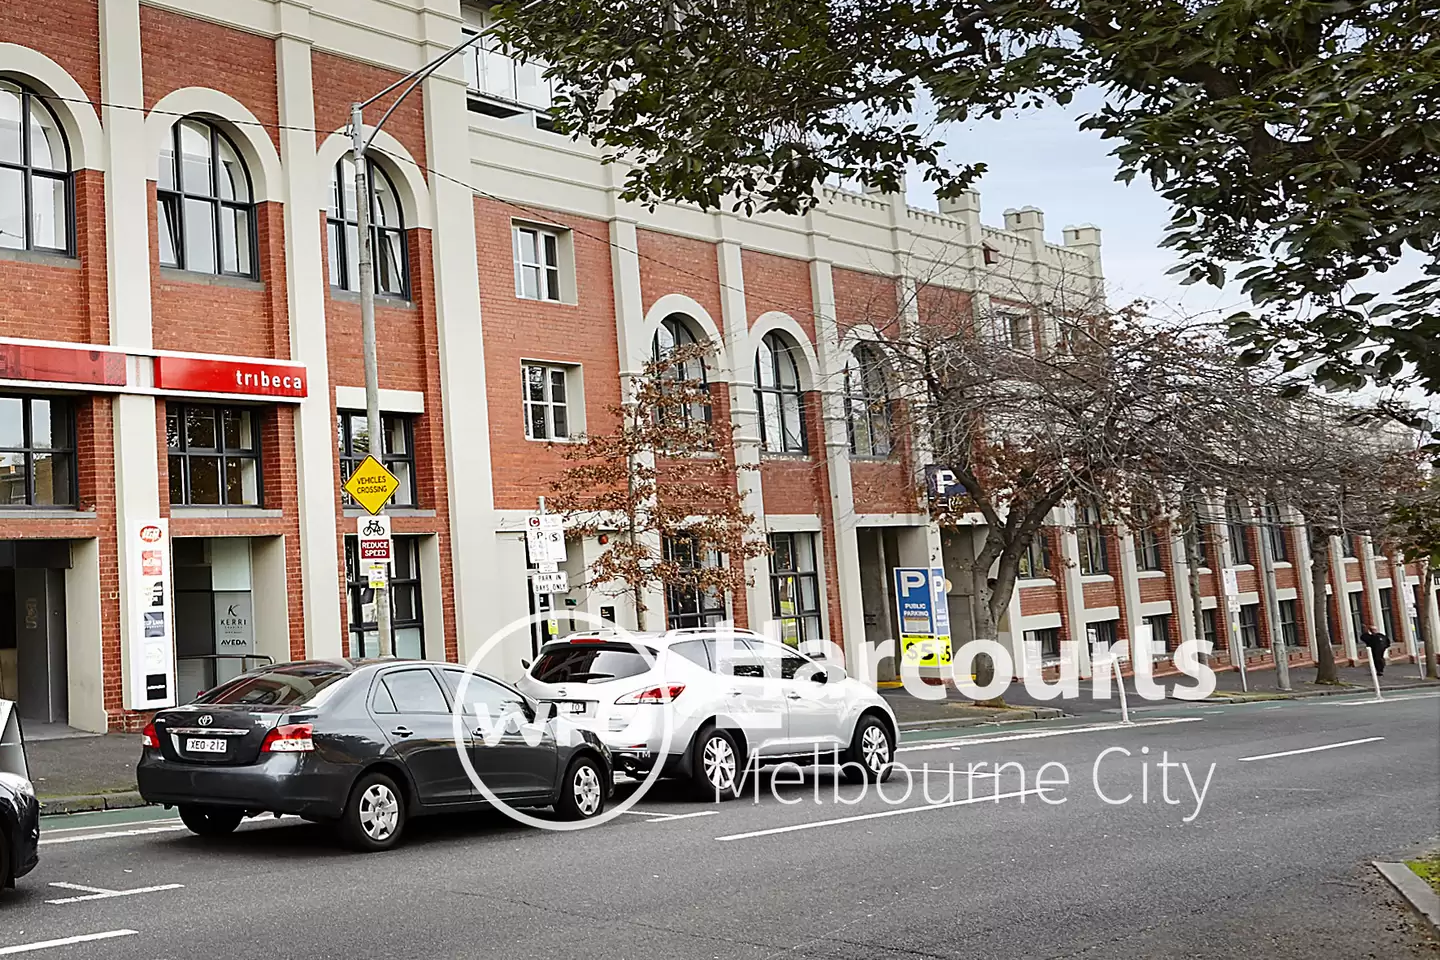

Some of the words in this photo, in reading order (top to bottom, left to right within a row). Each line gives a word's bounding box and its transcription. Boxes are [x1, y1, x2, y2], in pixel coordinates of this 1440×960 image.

[236, 370, 302, 389] tribeca
[357, 476, 386, 485] VEHICLES
[357, 486, 388, 494] CROSSING
[362, 541, 388, 549] REDUCE
[365, 549, 387, 557] SPEED
[901, 571, 926, 597] P
